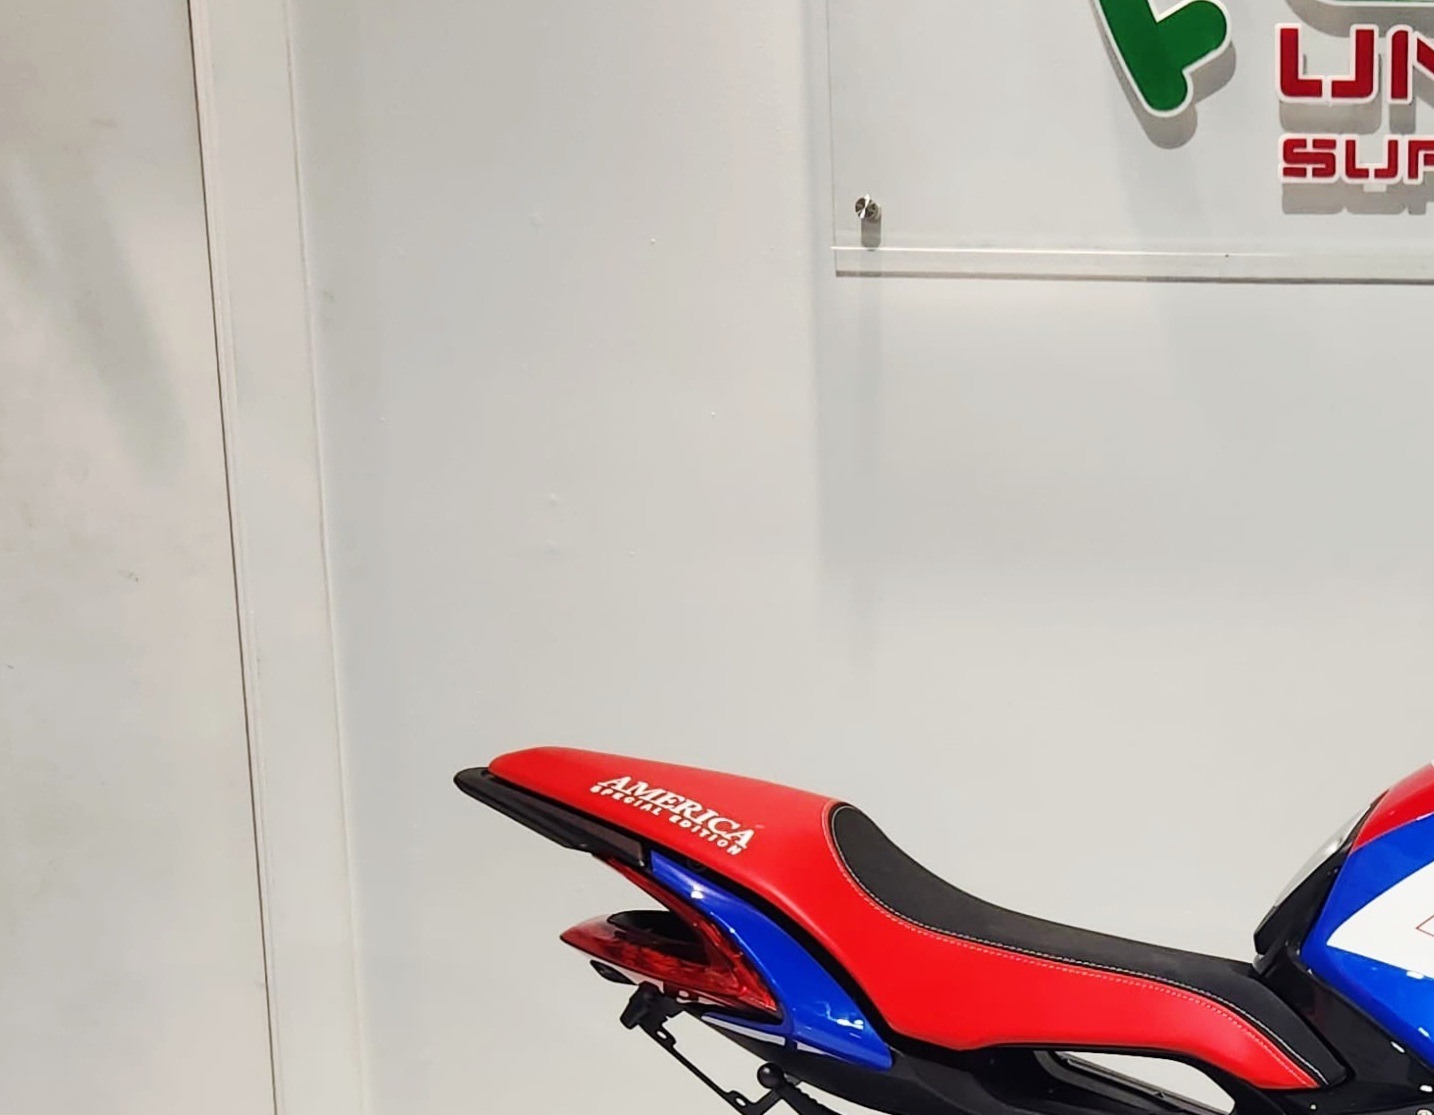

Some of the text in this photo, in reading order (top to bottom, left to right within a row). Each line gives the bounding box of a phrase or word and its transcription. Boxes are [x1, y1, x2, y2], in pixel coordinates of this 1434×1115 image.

[590, 785, 743, 856] SPECIAL EDITION
[597, 775, 754, 850] AMERICA
